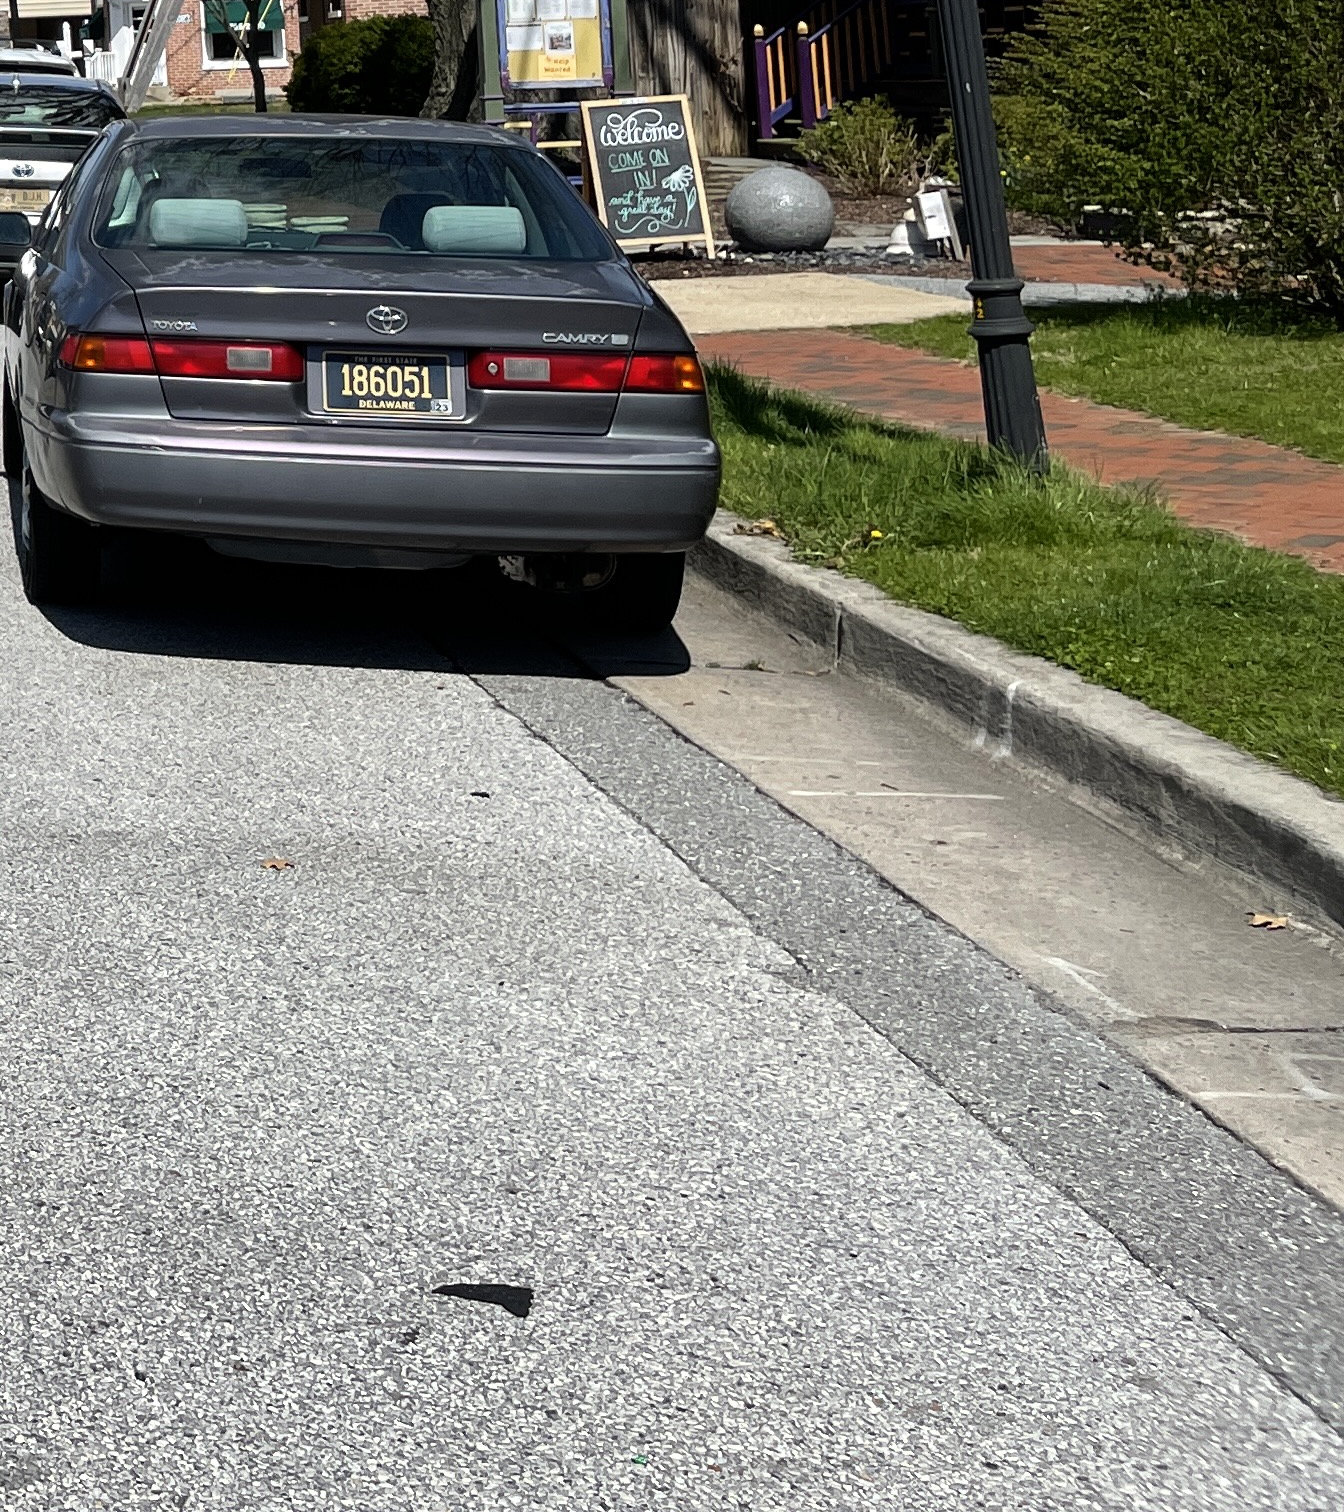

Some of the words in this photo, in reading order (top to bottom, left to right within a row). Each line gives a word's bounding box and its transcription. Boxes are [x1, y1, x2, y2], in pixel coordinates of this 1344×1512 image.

[600, 108, 685, 147] Welcome
[608, 150, 647, 170] COME
[649, 147, 669, 165] ON
[633, 169, 657, 188] IN!
[608, 190, 634, 206] and
[635, 189, 662, 206] have
[618, 204, 648, 222] great
[649, 202, 677, 223] day!
[151, 319, 198, 331] TOYOTA
[542, 332, 610, 344] CAMRY
[371, 356, 392, 364] FIRST
[395, 357, 418, 365] STATE
[341, 364, 433, 399] 186051
[358, 399, 416, 410] DELAWARE
[435, 403, 449, 412] 23
